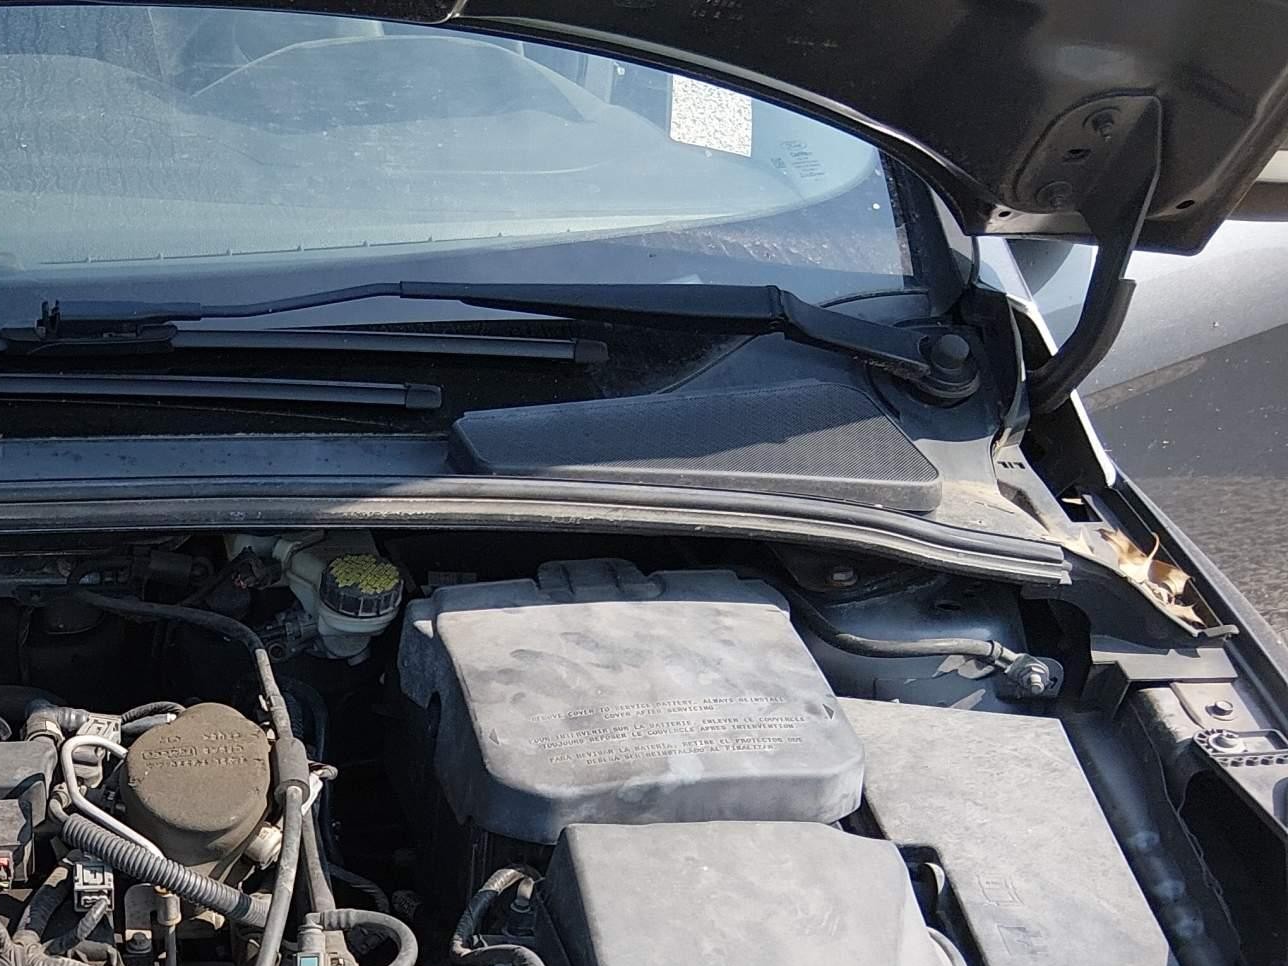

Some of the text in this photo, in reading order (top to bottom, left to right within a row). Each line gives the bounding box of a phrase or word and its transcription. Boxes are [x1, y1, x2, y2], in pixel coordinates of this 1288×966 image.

[567, 709, 594, 718] COVER
[616, 703, 651, 711] SERVICE
[604, 710, 631, 720] COVER
[636, 707, 662, 716] AFTER
[613, 725, 630, 733] SUR
[543, 738, 585, 749] TOUJOURS
[589, 732, 627, 742] REPOSER
[648, 726, 695, 736] COUVERCLE
[645, 747, 705, 758] REINSTALADO
